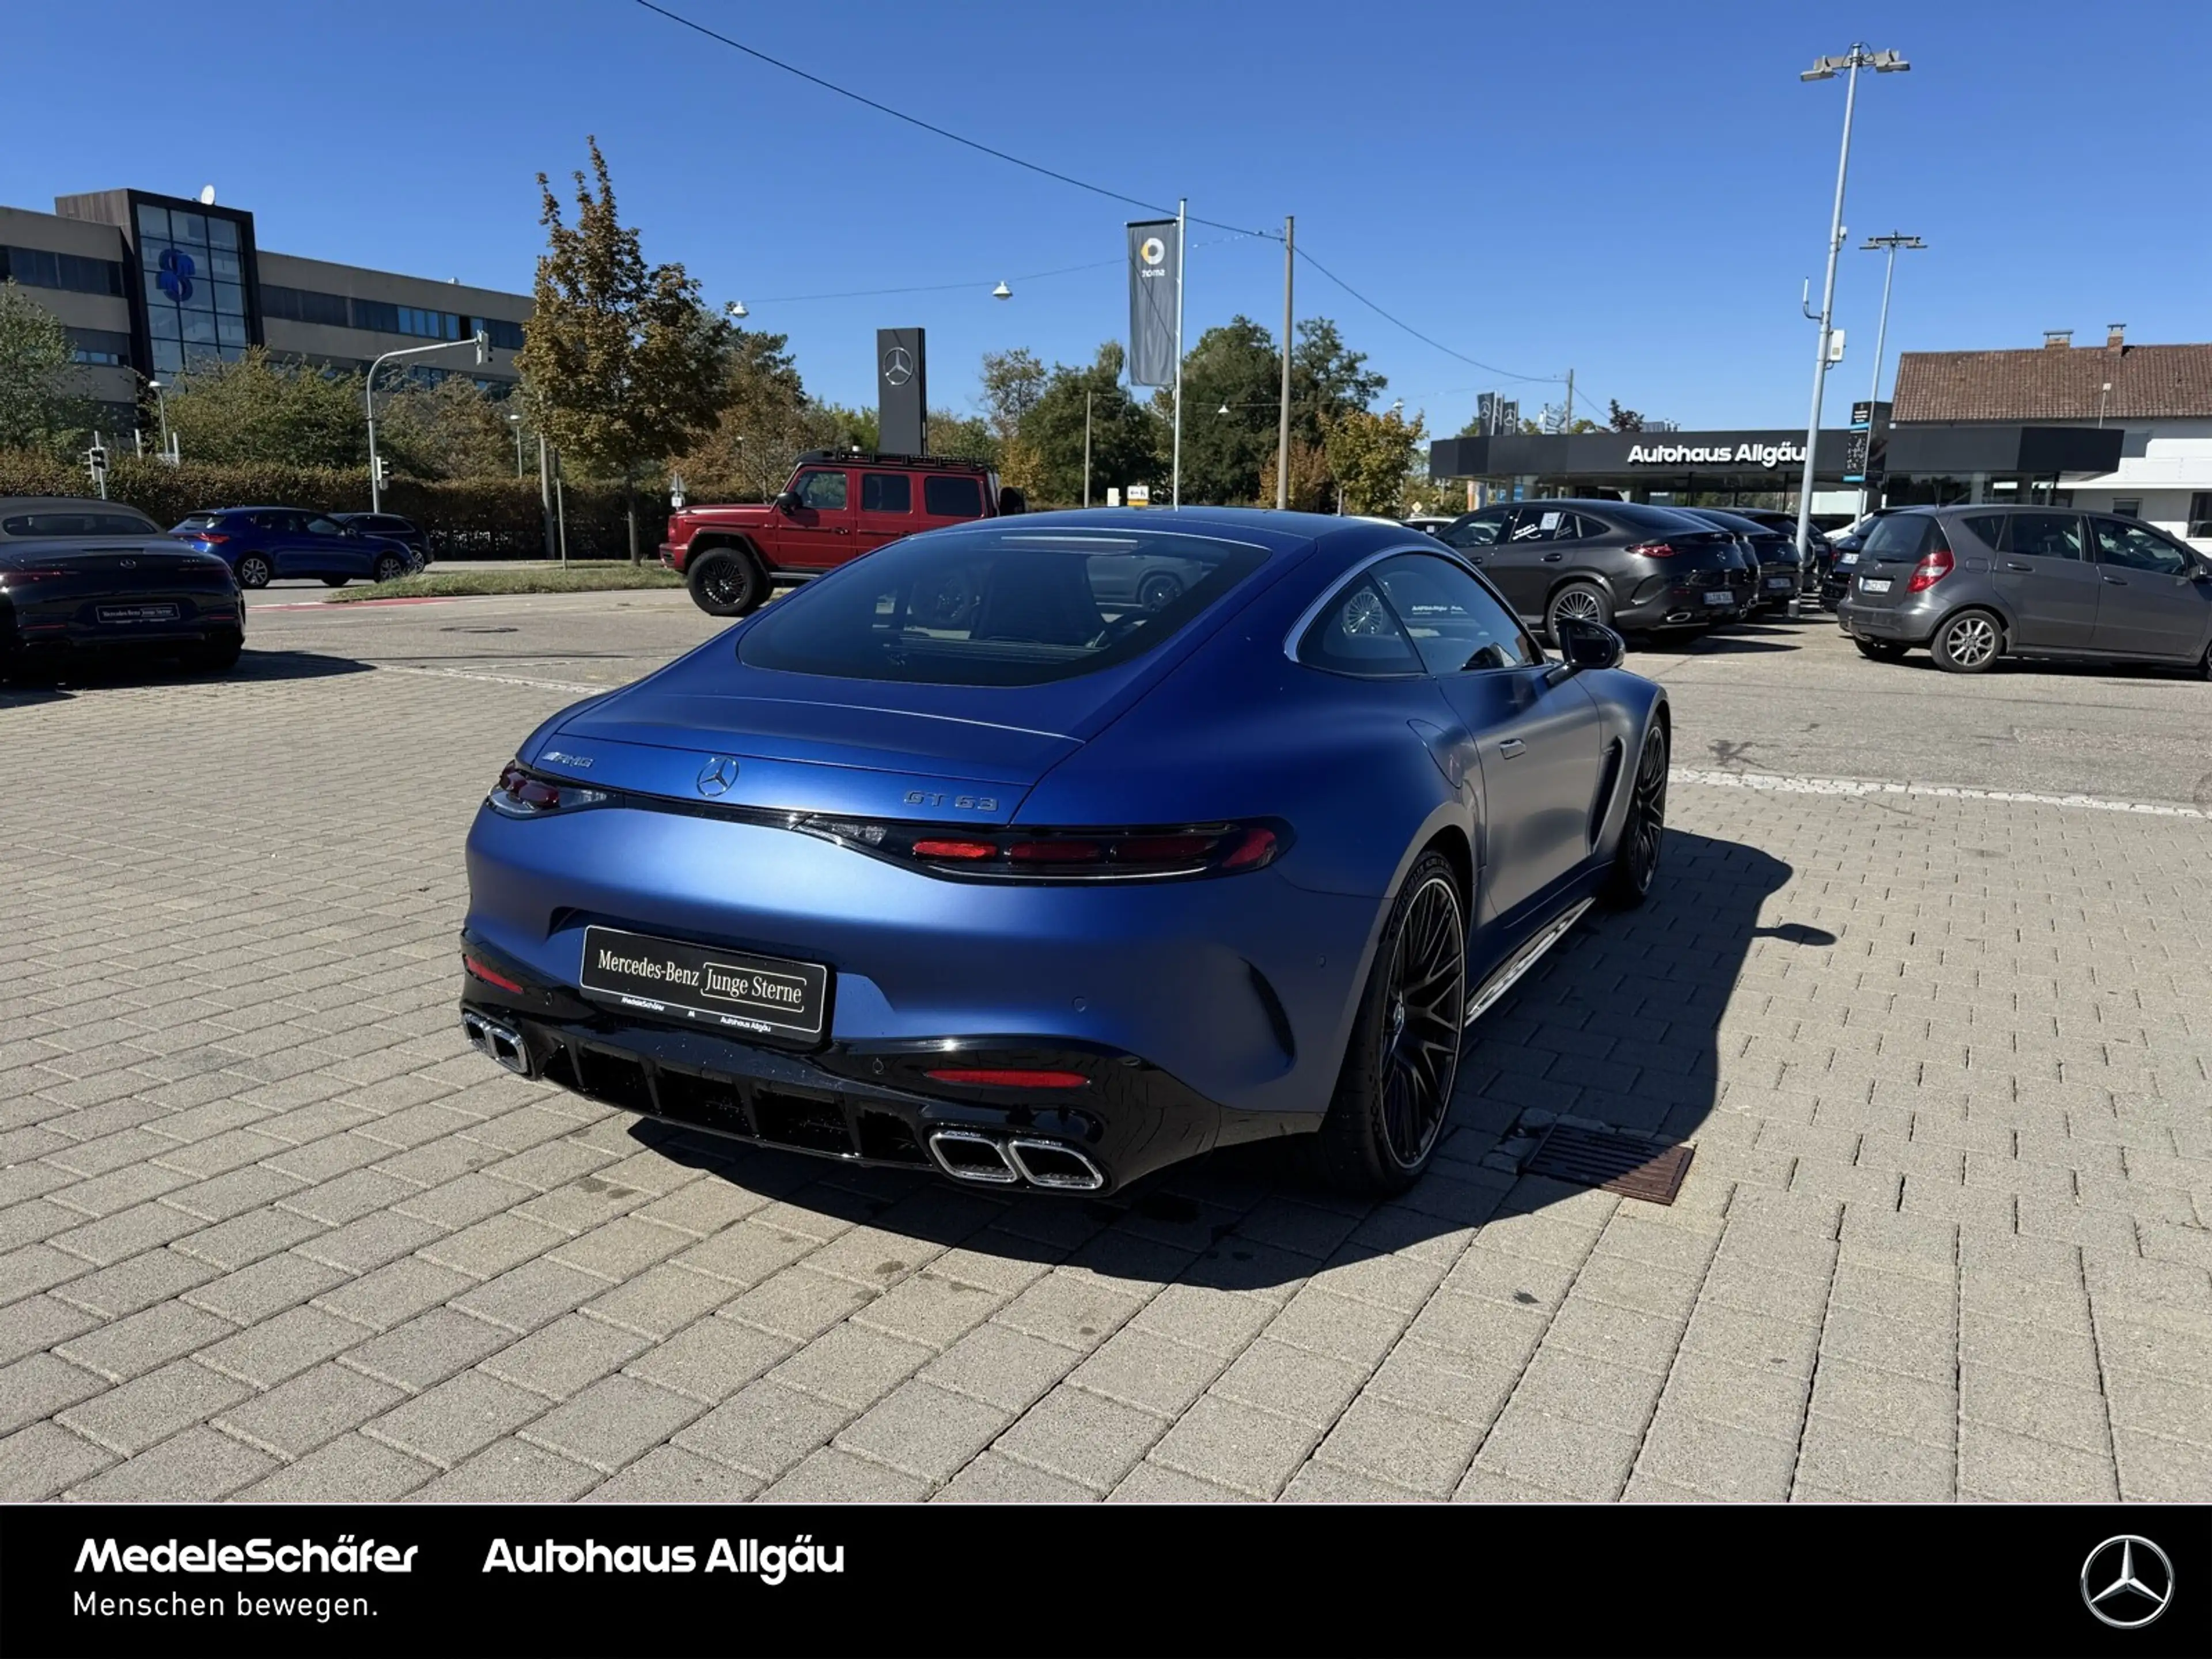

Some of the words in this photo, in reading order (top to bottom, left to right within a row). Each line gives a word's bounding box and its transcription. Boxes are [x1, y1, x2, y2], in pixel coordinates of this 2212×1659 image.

[1627, 440, 1732, 463] Autohaus
[1734, 441, 1807, 468] Allgäu
[904, 791, 949, 807] GT
[955, 796, 999, 812] 63
[598, 949, 699, 987] Mercedes-Benz
[704, 968, 749, 998] Junge
[751, 976, 802, 1004] Sterne
